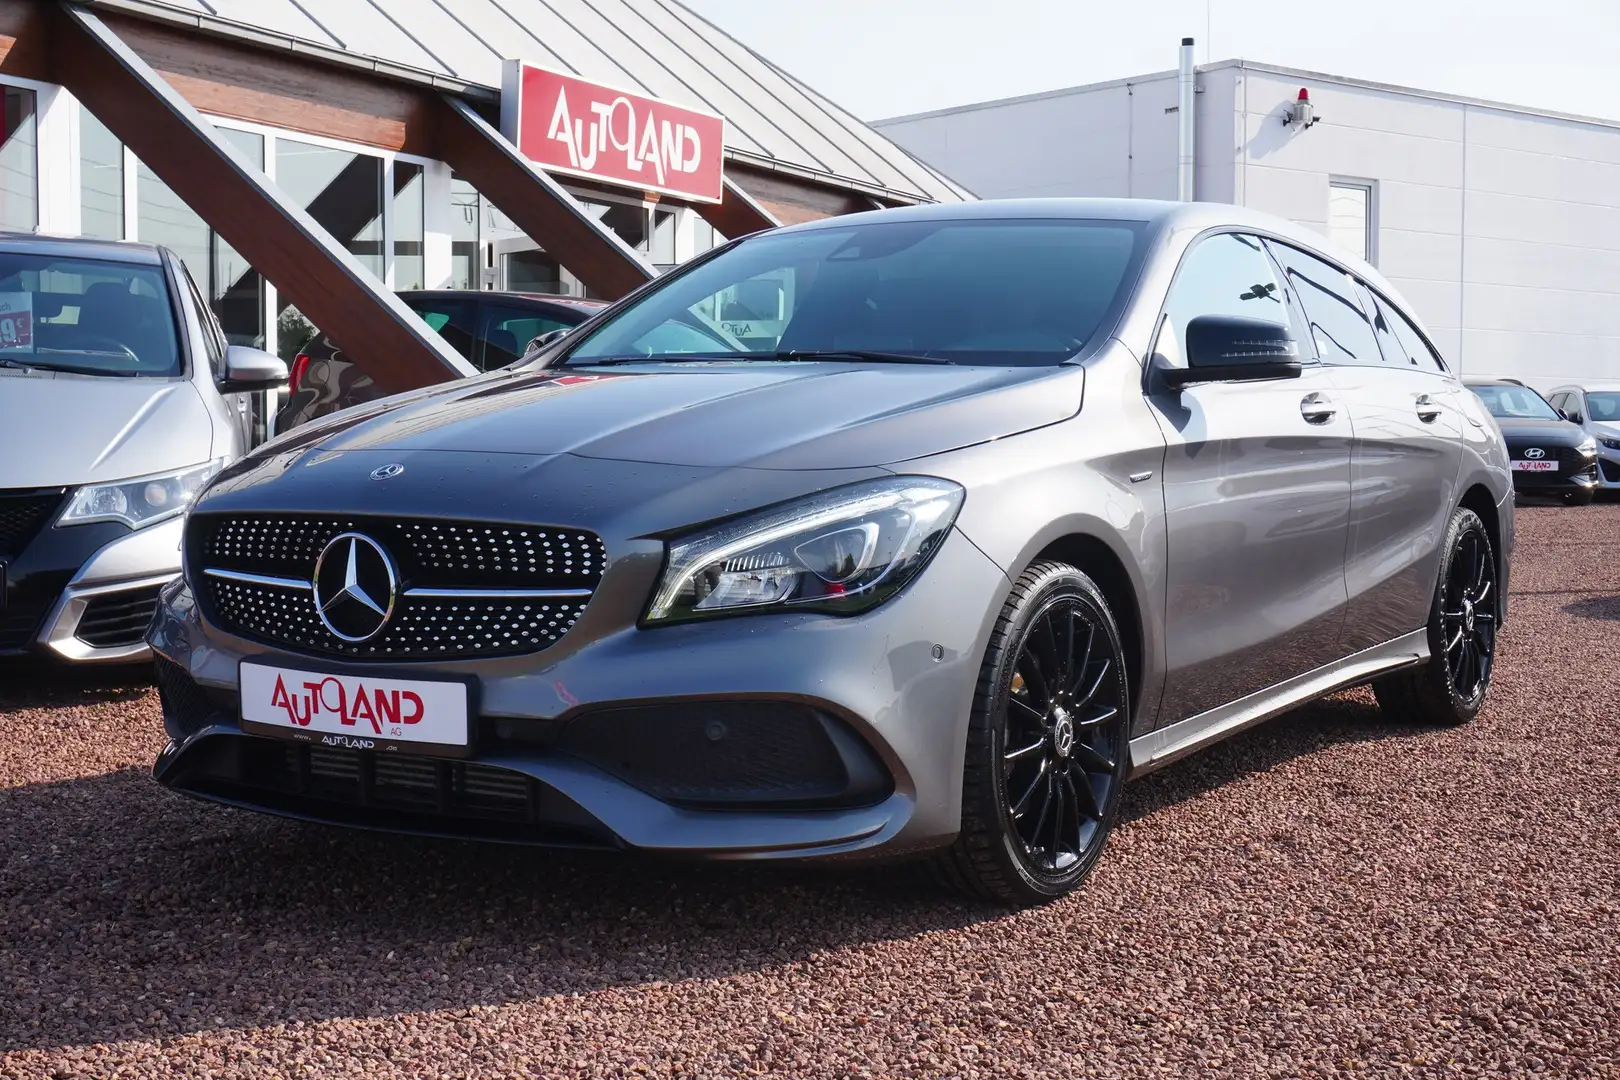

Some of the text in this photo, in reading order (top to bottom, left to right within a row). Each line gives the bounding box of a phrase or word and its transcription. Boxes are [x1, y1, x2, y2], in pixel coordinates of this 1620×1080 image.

[546, 84, 702, 186] AUTOLAND
[0, 318, 16, 342] 9
[271, 673, 424, 734] AUTOLAND
[321, 735, 375, 749] AUTOLAND
[390, 727, 402, 737] AG
